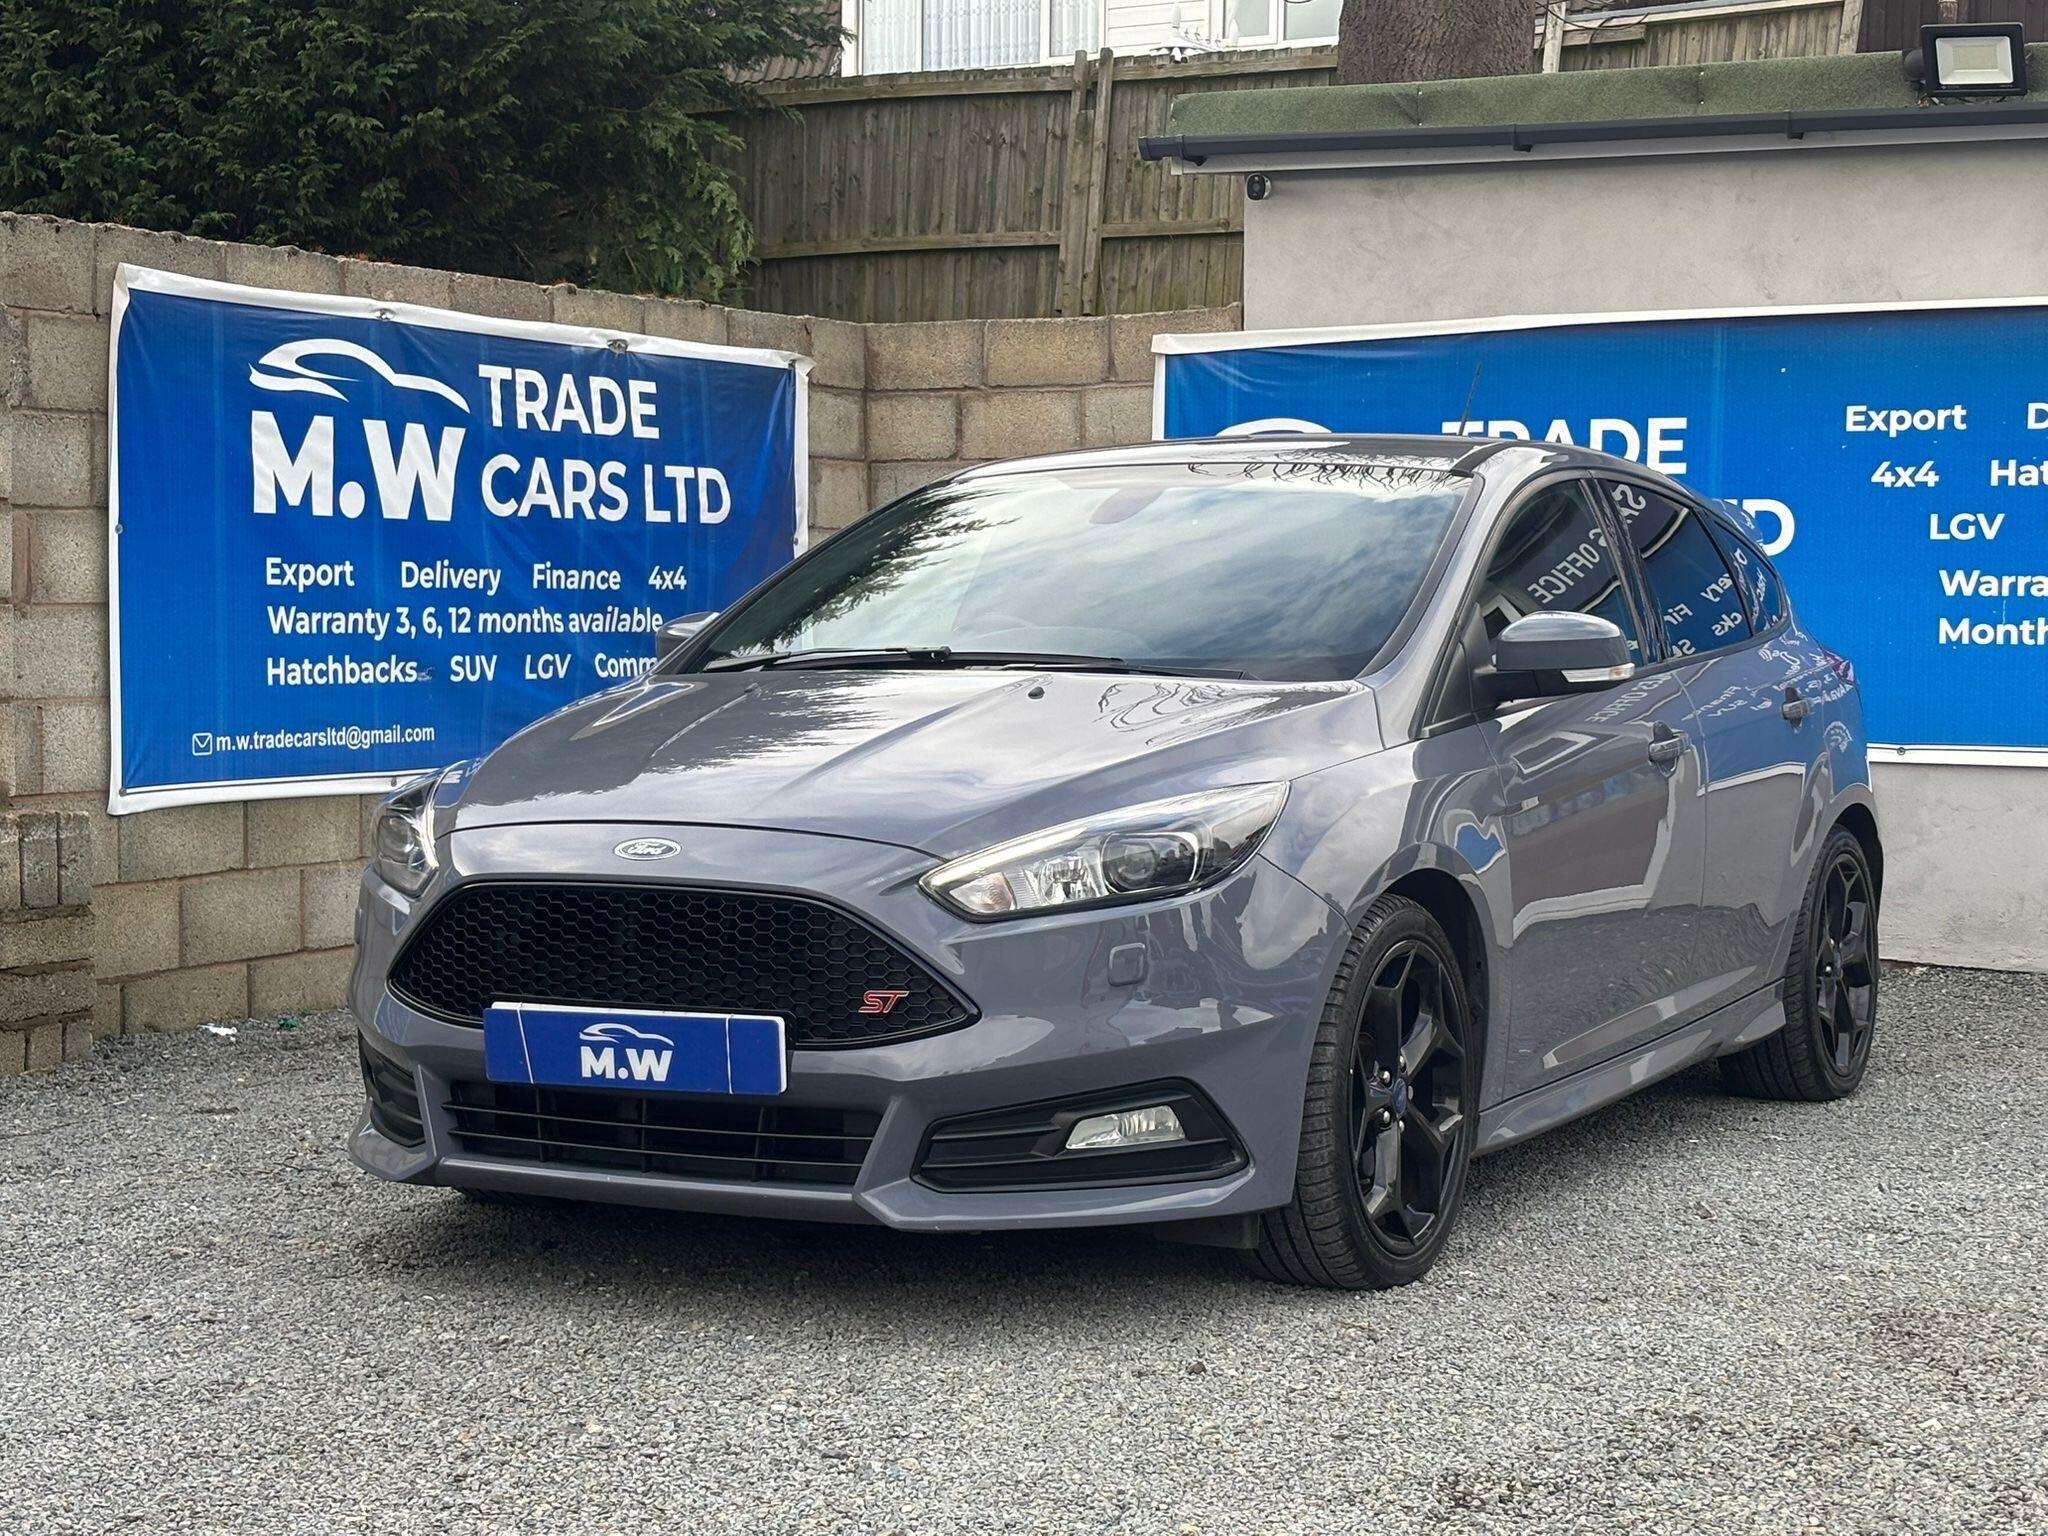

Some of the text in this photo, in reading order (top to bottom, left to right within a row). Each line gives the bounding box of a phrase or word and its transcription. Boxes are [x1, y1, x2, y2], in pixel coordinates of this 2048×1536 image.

[478, 363, 661, 439] TRADE
[1845, 404, 1968, 438] Export
[250, 410, 467, 521] M.W
[1870, 460, 1940, 488] 4x4
[480, 453, 732, 525] CARS LTD
[1929, 512, 2006, 541] LGV
[266, 556, 688, 597] Export Delivery Finance 4x4
[266, 605, 664, 642] Warranty 3, 6, 12 months available
[266, 654, 418, 686] Hatchbacks
[450, 654, 499, 683] SUV
[524, 653, 572, 680] LGV
[215, 724, 435, 752] m.w.tradecarsltd@gmail.com
[627, 841, 668, 855] Ford
[858, 990, 910, 1014] ST
[580, 1045, 673, 1082] M.W
